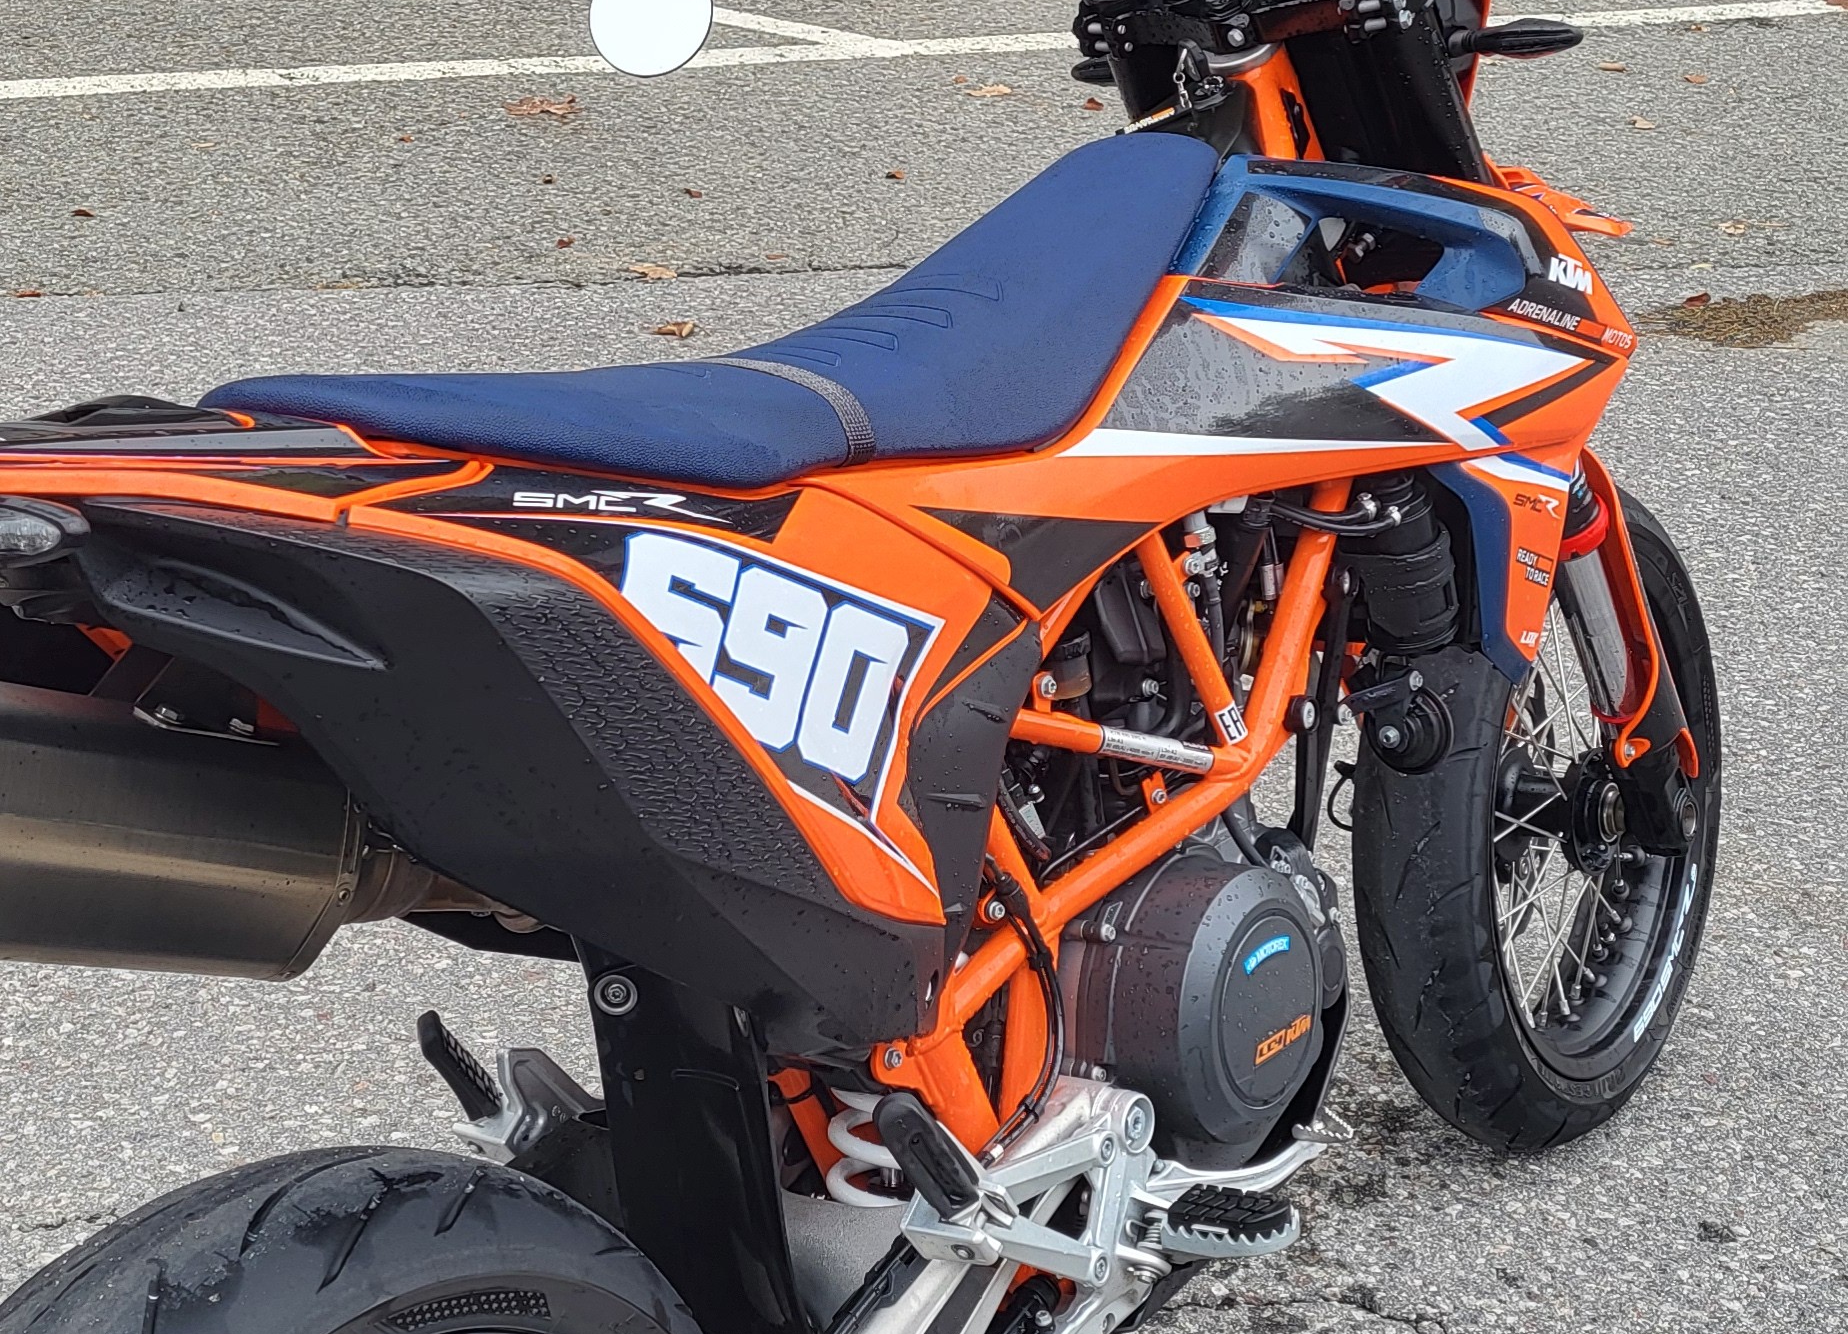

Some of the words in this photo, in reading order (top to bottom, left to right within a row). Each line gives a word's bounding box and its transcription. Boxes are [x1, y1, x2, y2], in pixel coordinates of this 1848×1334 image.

[1548, 253, 1593, 295] KTM
[1507, 298, 1581, 331] ADRENALINE
[1601, 327, 1633, 349] MOTOS
[1516, 548, 1539, 566] READY
[1525, 566, 1535, 581] TO
[1534, 570, 1550, 587] RACE
